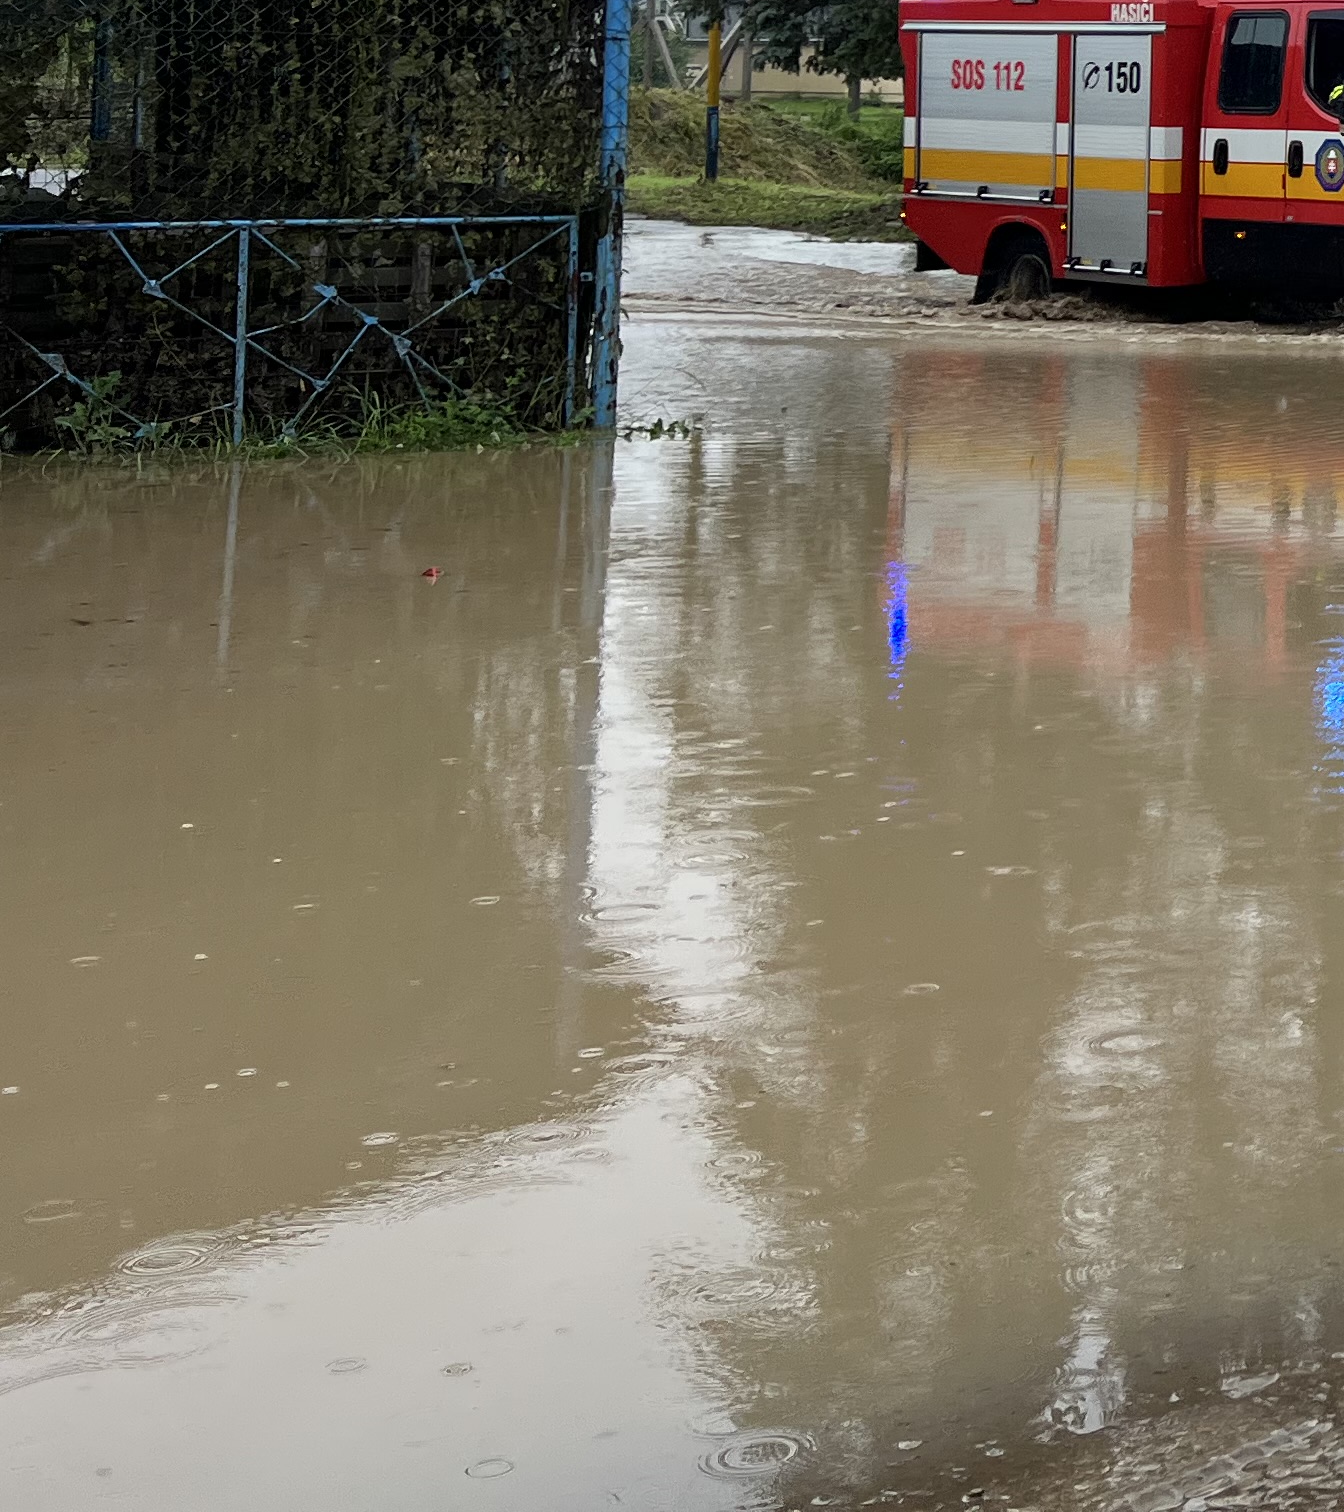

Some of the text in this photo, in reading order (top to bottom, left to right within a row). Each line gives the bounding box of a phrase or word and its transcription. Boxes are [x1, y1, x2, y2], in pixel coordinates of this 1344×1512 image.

[1111, 0, 1154, 22] HASIČI
[951, 59, 1025, 91] SOS 112
[1105, 61, 1141, 93] 150
